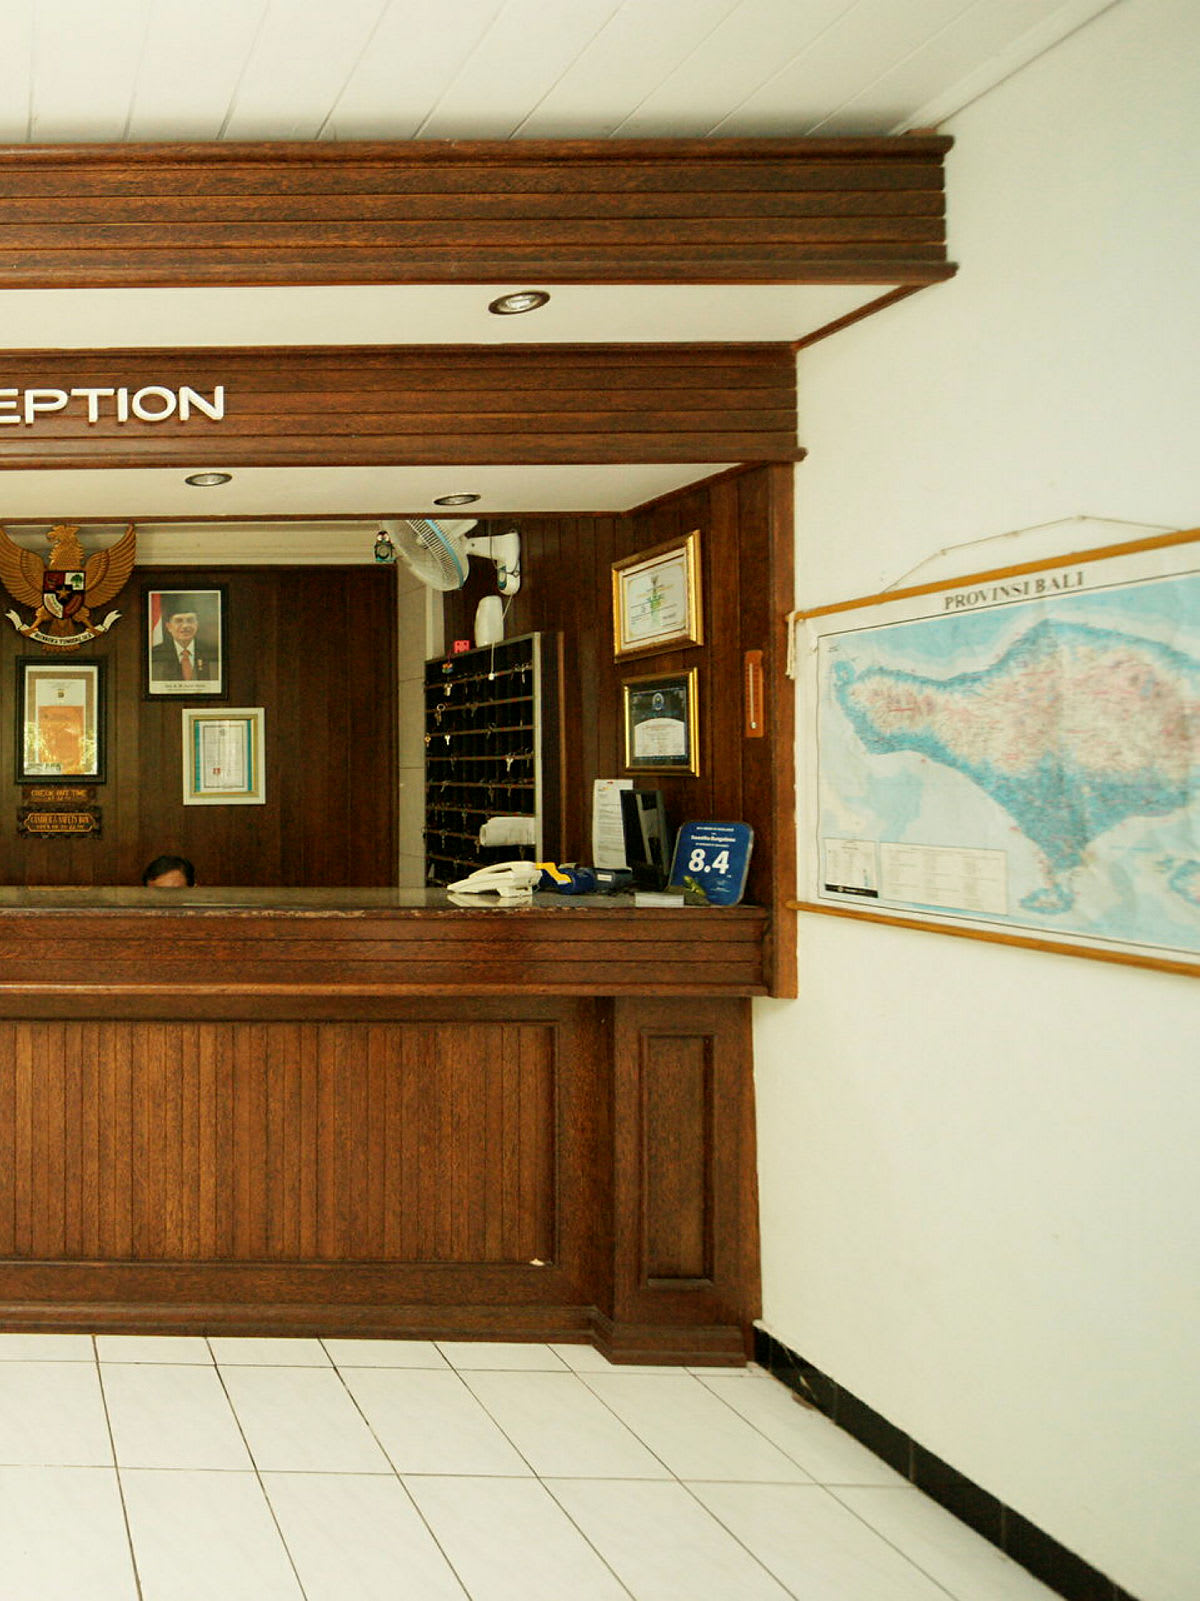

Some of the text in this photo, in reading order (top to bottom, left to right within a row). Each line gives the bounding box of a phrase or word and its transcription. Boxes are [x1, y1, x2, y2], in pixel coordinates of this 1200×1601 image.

[943, 571, 1085, 610] PROVINSI BALI
[688, 848, 730, 874] 8.4
